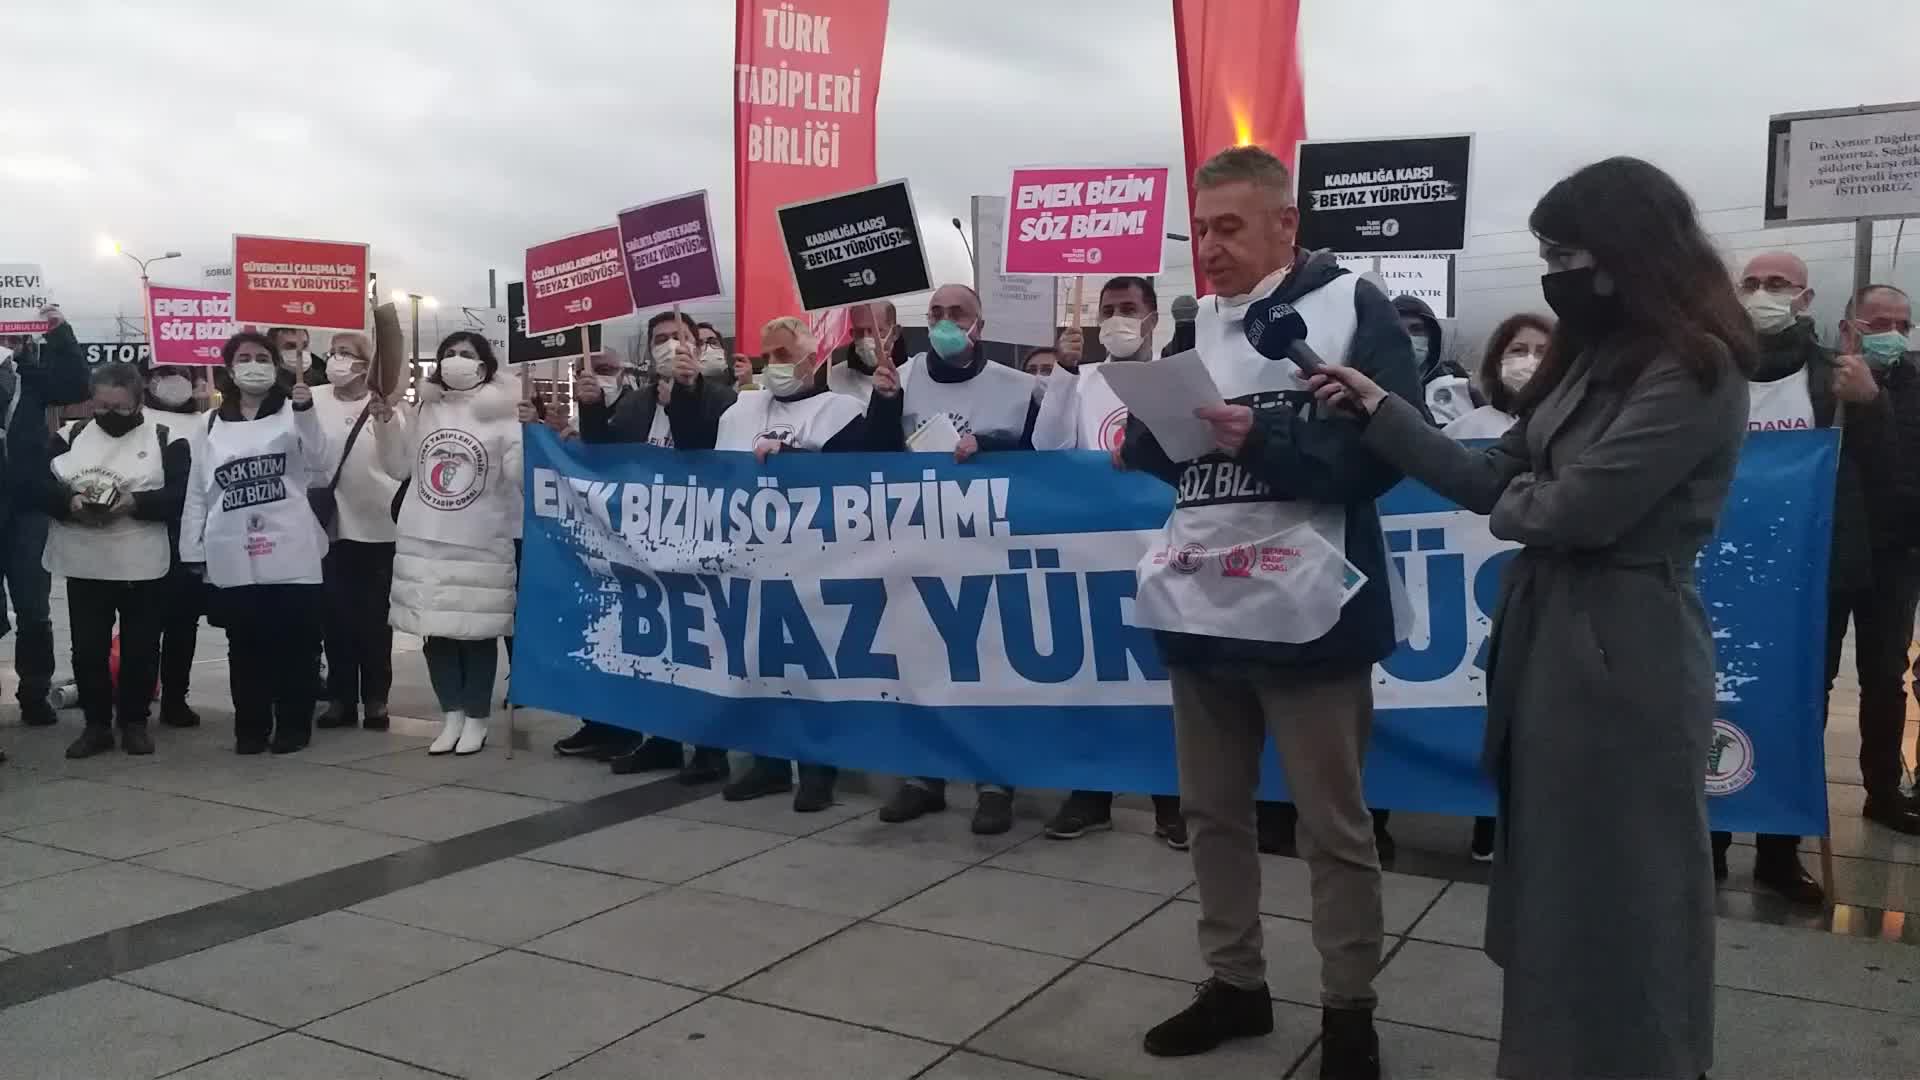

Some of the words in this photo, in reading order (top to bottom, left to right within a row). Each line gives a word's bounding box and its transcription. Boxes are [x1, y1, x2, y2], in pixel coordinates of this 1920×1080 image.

[762, 3, 831, 54] TÜRK
[735, 61, 861, 113] TABİPLERİ
[748, 116, 840, 168] BİRLİĞİ
[1016, 181, 1085, 210] EMEK
[1085, 173, 1155, 206] BİZİM
[1325, 167, 1396, 187] KARANLIĞA
[1396, 165, 1434, 181] KARŞI
[1319, 190, 1366, 208] BEYAZ
[1370, 184, 1446, 202] YÜRÜYÜŞ!
[805, 223, 858, 248] KARANLIĞA
[855, 215, 887, 233] KARŞI
[1018, 211, 1070, 242] SÖZ
[1070, 207, 1147, 238] BİZİM!
[635, 250, 658, 268] BEYAZ
[807, 246, 843, 267] BEYAZ
[842, 230, 902, 257] YÜRÜYÜŞ!
[253, 277, 289, 288] BEYAZ
[292, 278, 350, 291] YÜRÜYÜŞ!
[294, 263, 336, 275] ÇALIŞMA
[539, 278, 569, 295] BEYAZ
[569, 263, 617, 287] YÜRÜYÜŞ!
[154, 298, 202, 317] EMEK
[160, 318, 194, 341] SÖZ
[87, 344, 150, 363] STOP
[215, 461, 248, 488] EMEK
[247, 454, 285, 479] BİZİM
[223, 485, 247, 510] SÖZ
[246, 479, 285, 504] BİZİM
[534, 467, 620, 537] EMEK
[620, 474, 725, 542] BİZİM
[728, 476, 823, 545] SÖZ
[832, 474, 1010, 542] BİZİM!
[609, 561, 900, 682] BEYAZ
